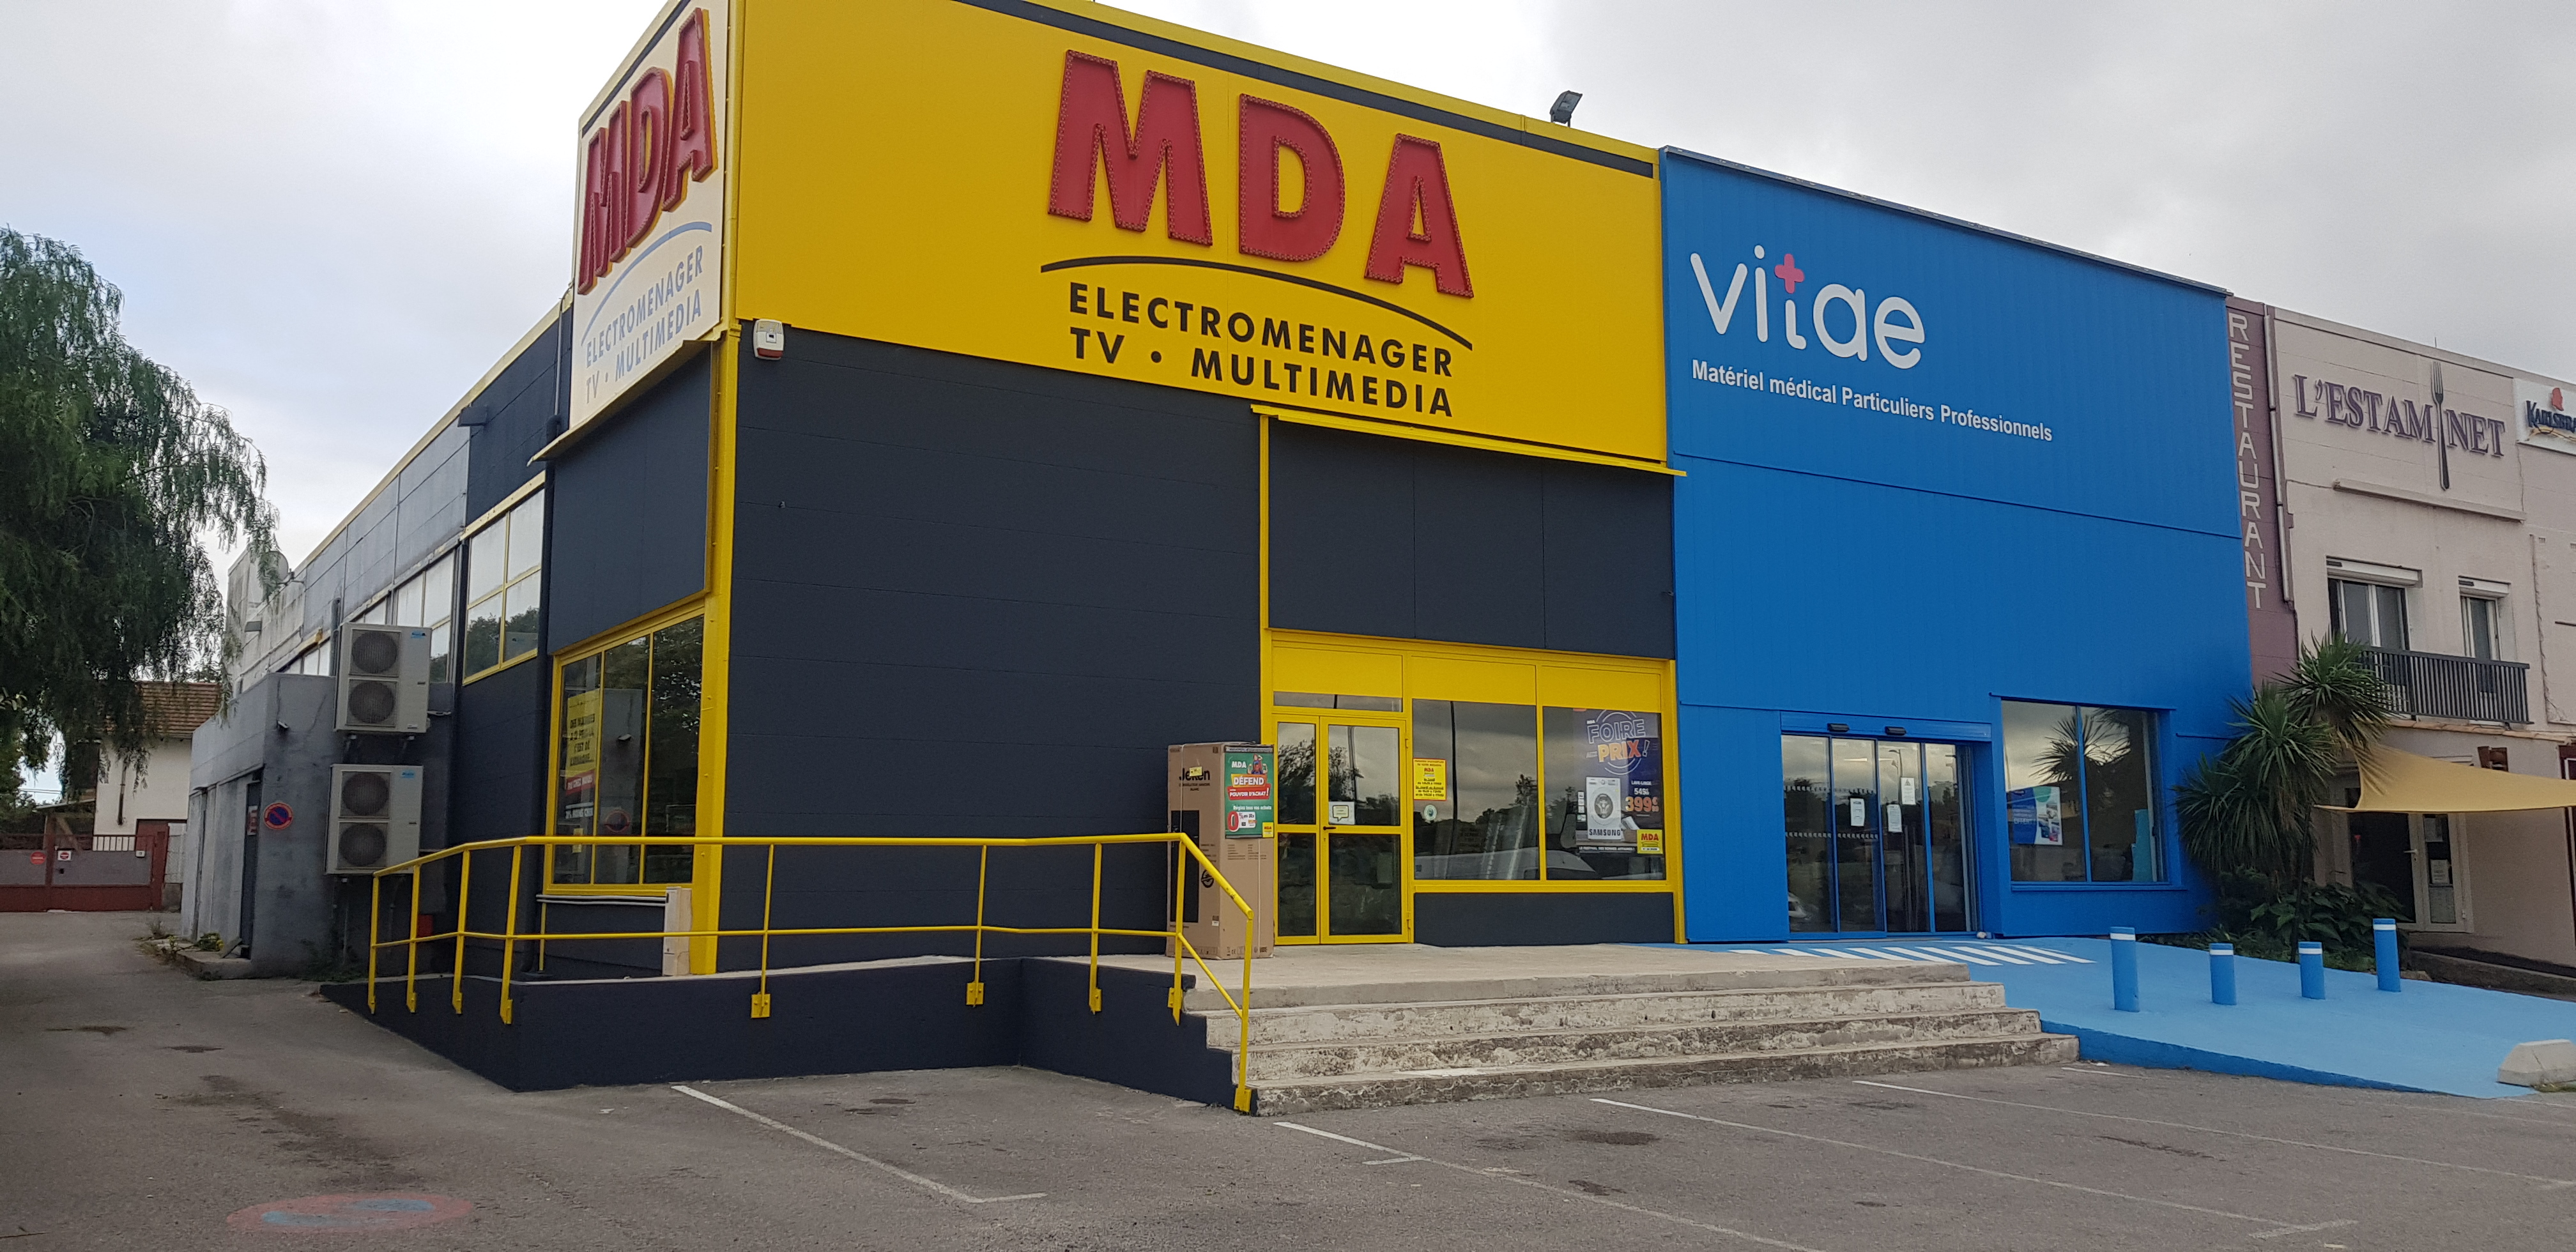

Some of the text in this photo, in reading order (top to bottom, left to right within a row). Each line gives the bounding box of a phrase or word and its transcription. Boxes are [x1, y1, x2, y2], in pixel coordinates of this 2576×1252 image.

[578, 7, 716, 294] MDA
[1048, 49, 1474, 298] MDA
[585, 288, 702, 404] TV MULTIMEDIA
[586, 245, 703, 369] ELECTROMENAGER
[1069, 282, 1452, 377] ELECTROMENAGER
[1070, 326, 1453, 418] TV MULTIMEDIA
[1692, 359, 2053, 443] Matériel médical Particuliers Professionnels
[2228, 312, 2267, 610] RESTAURANT
[1234, 775, 1264, 785] DÉFEND
[1587, 719, 1646, 744] FOIRE
